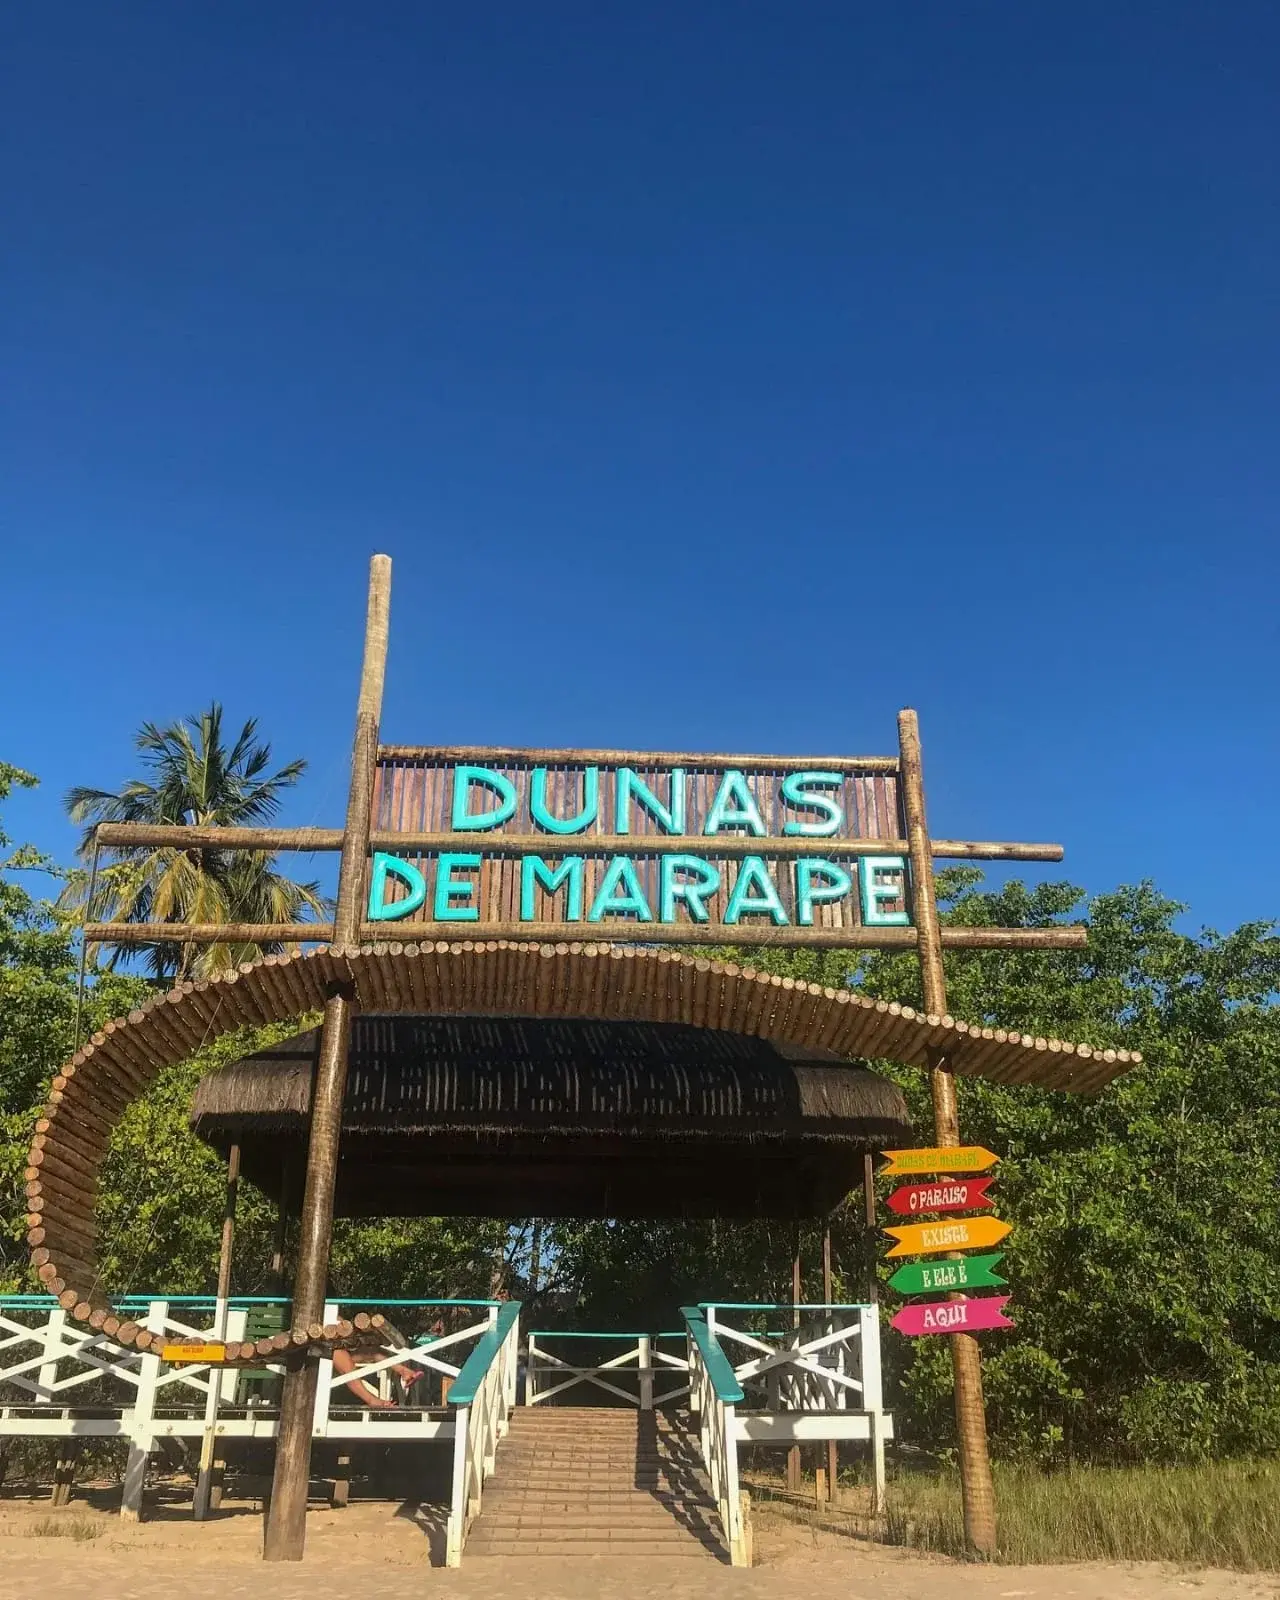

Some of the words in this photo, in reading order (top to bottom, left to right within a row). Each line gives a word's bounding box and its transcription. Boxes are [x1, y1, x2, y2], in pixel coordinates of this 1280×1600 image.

[451, 766, 846, 837] DUNAS
[367, 852, 481, 923] DE
[521, 853, 910, 926] MARAPE
[910, 1192, 917, 1210] O
[919, 1186, 968, 1209] PARAISO
[922, 1224, 969, 1248] EXISTE
[922, 1270, 931, 1288] E
[933, 1266, 956, 1287] ELE
[958, 1259, 968, 1284] É
[923, 1304, 968, 1328] AQUI
